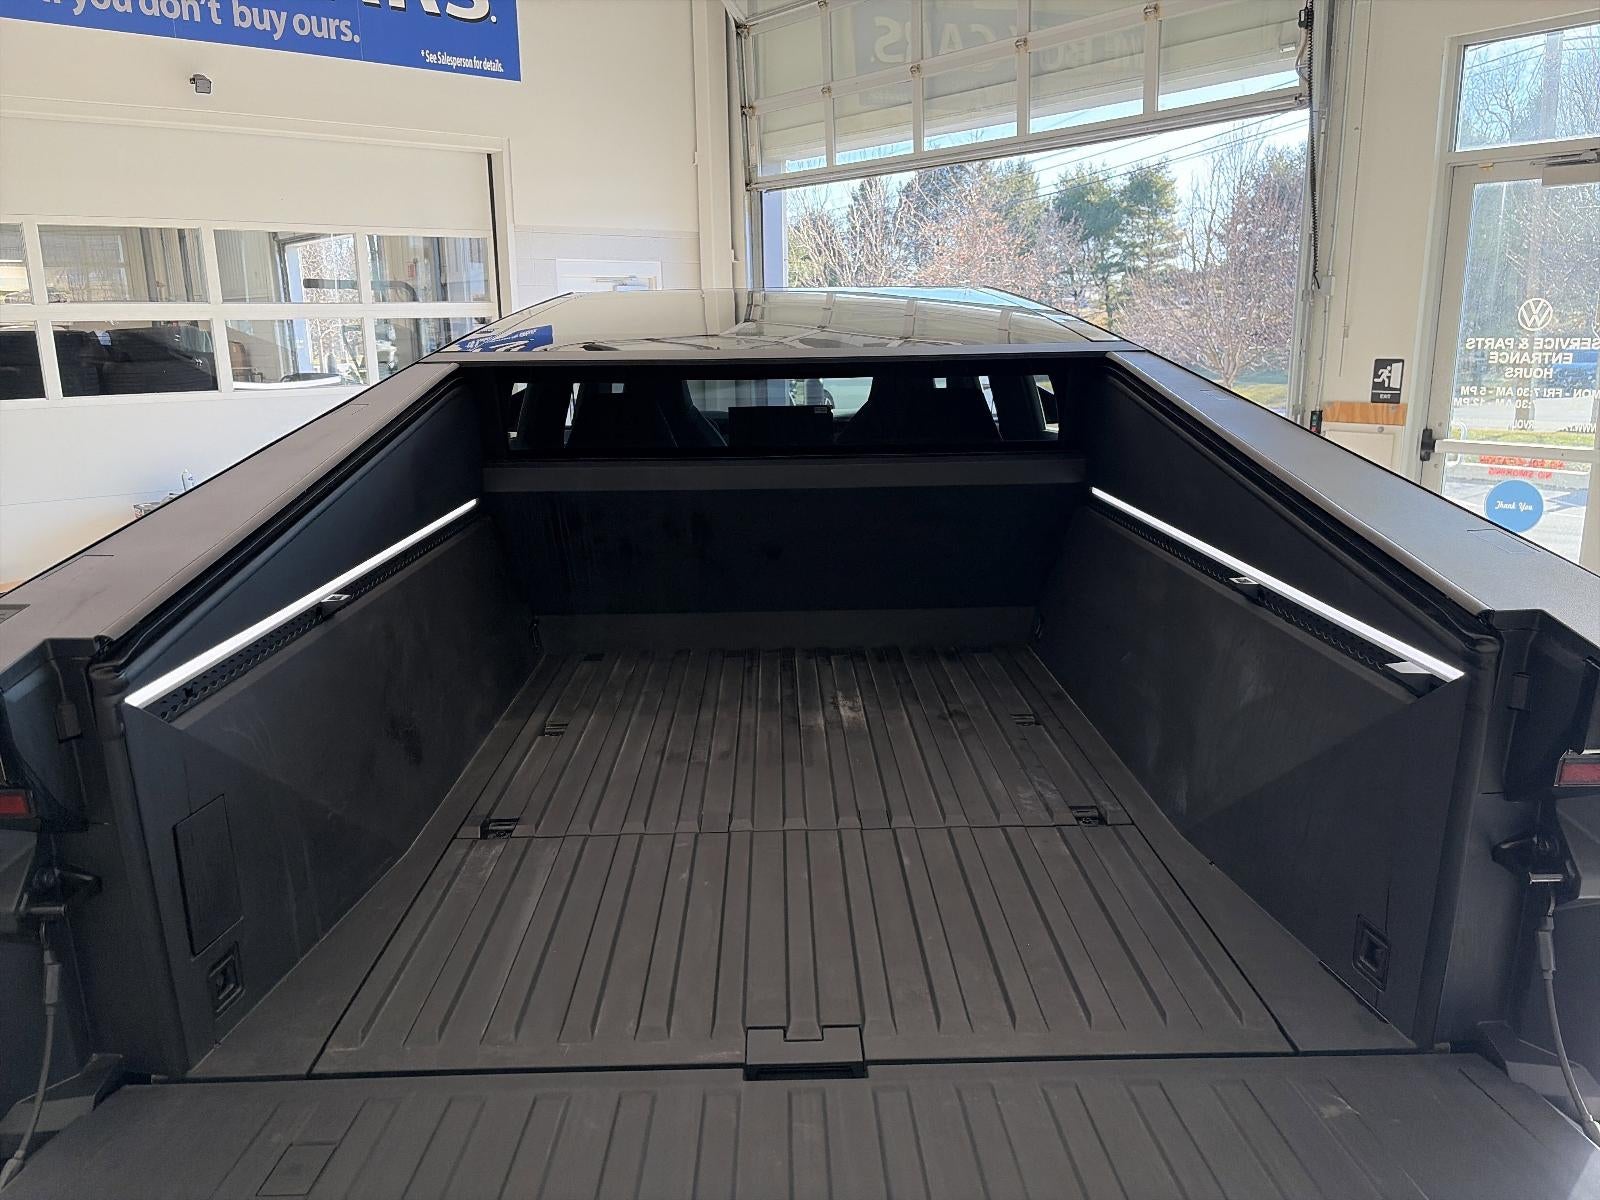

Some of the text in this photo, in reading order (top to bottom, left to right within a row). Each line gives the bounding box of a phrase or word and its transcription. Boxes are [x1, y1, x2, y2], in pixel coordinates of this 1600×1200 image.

[232, 0, 287, 41] buy
[292, 13, 361, 43] ours.
[437, 51, 473, 69] Salesperson
[473, 56, 483, 69] for
[482, 58, 504, 72] details.
[1519, 502, 1533, 512] You
